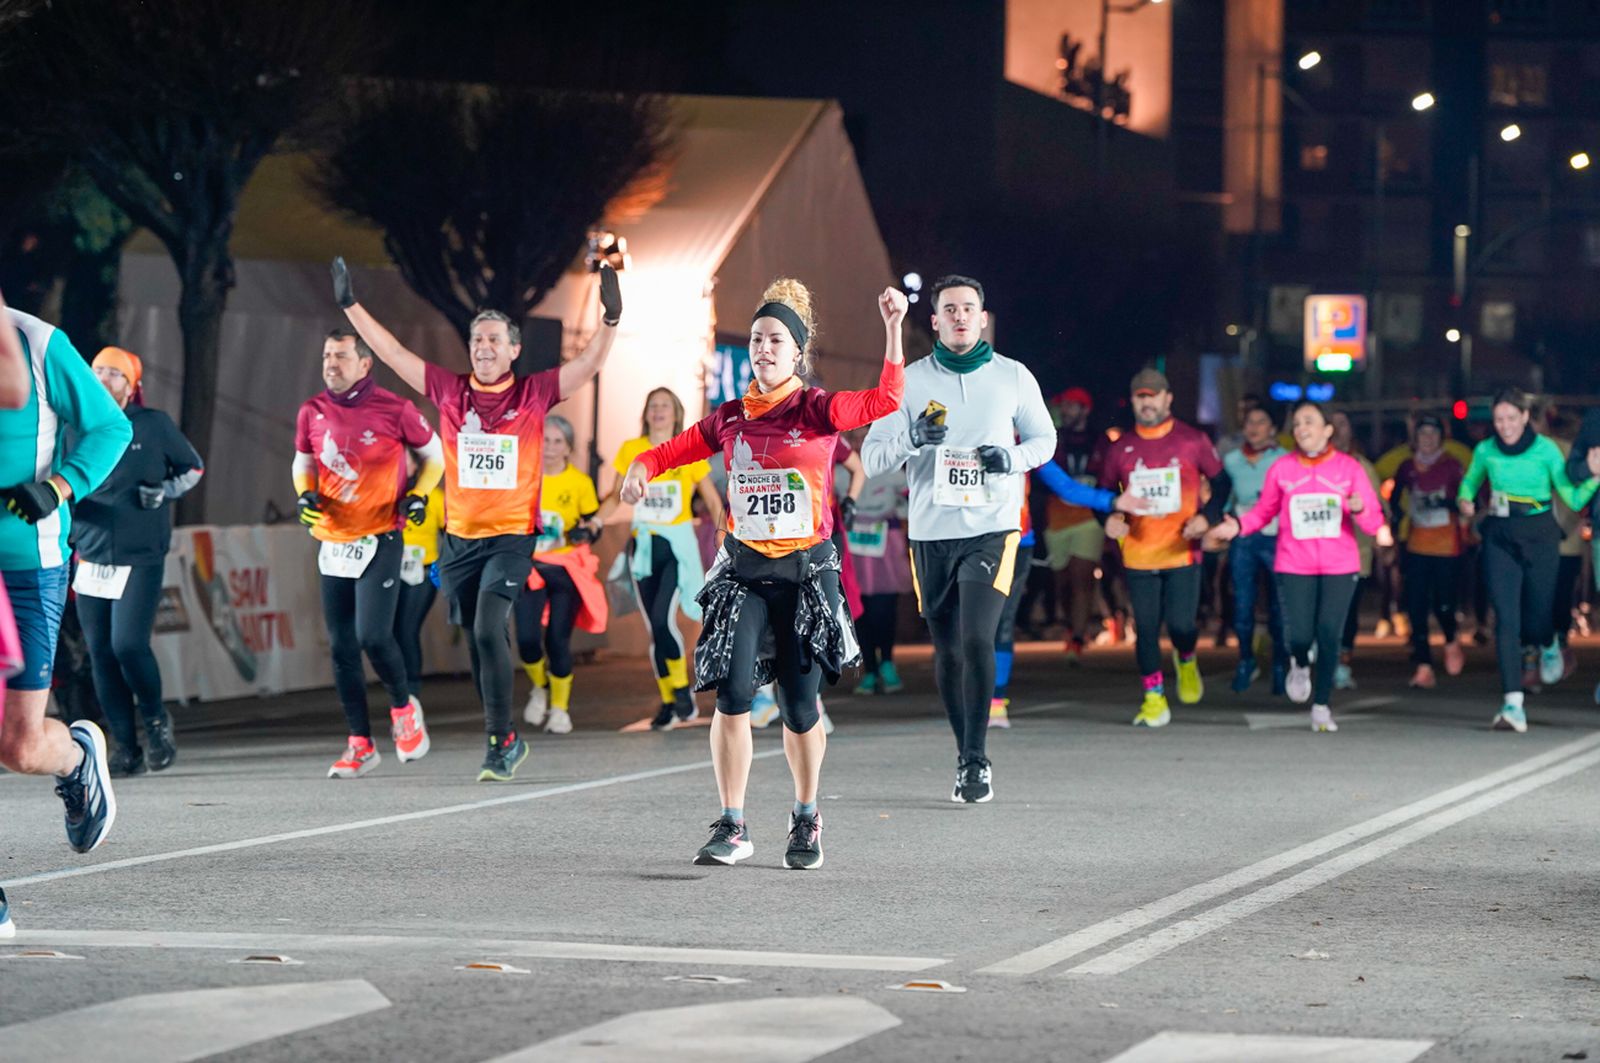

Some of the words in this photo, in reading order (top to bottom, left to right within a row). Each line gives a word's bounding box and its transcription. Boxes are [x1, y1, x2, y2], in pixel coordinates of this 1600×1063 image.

[468, 453, 505, 471] 7256
[747, 475, 771, 484] NOCHE
[771, 475, 782, 483] DE
[948, 467, 986, 486] 6531
[739, 485, 755, 494] SAN
[747, 492, 796, 516] 2158
[228, 567, 269, 608] SAN
